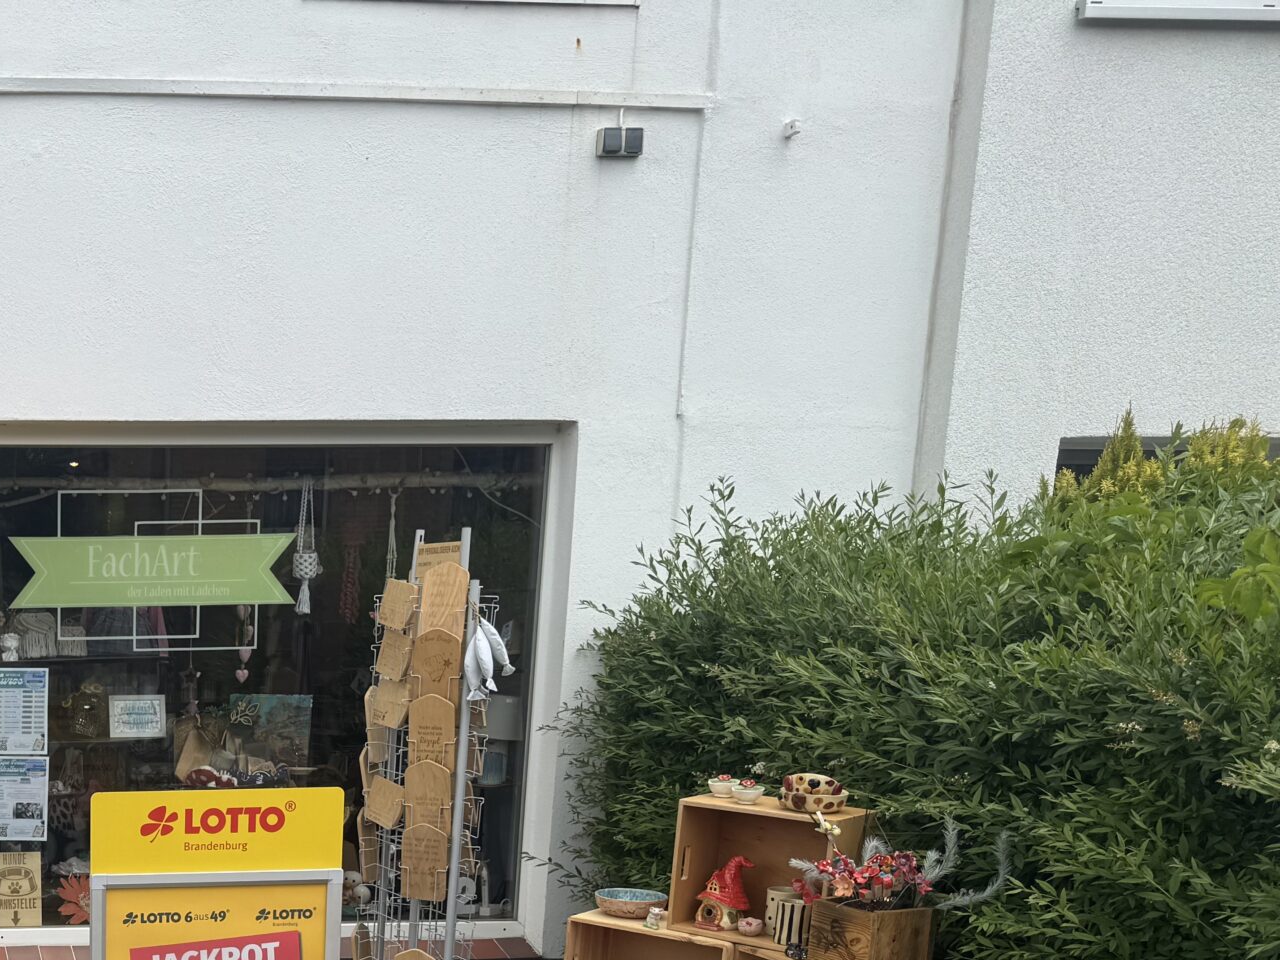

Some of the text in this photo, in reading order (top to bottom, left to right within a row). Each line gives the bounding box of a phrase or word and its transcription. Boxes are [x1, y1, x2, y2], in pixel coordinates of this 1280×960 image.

[87, 542, 200, 579] FachArt
[184, 807, 286, 835] LOTTO
[183, 840, 248, 853] Brandenburg
[3, 853, 26, 865] HUNDE
[140, 912, 181, 924] LOTTO
[272, 908, 313, 920] LOTTO
